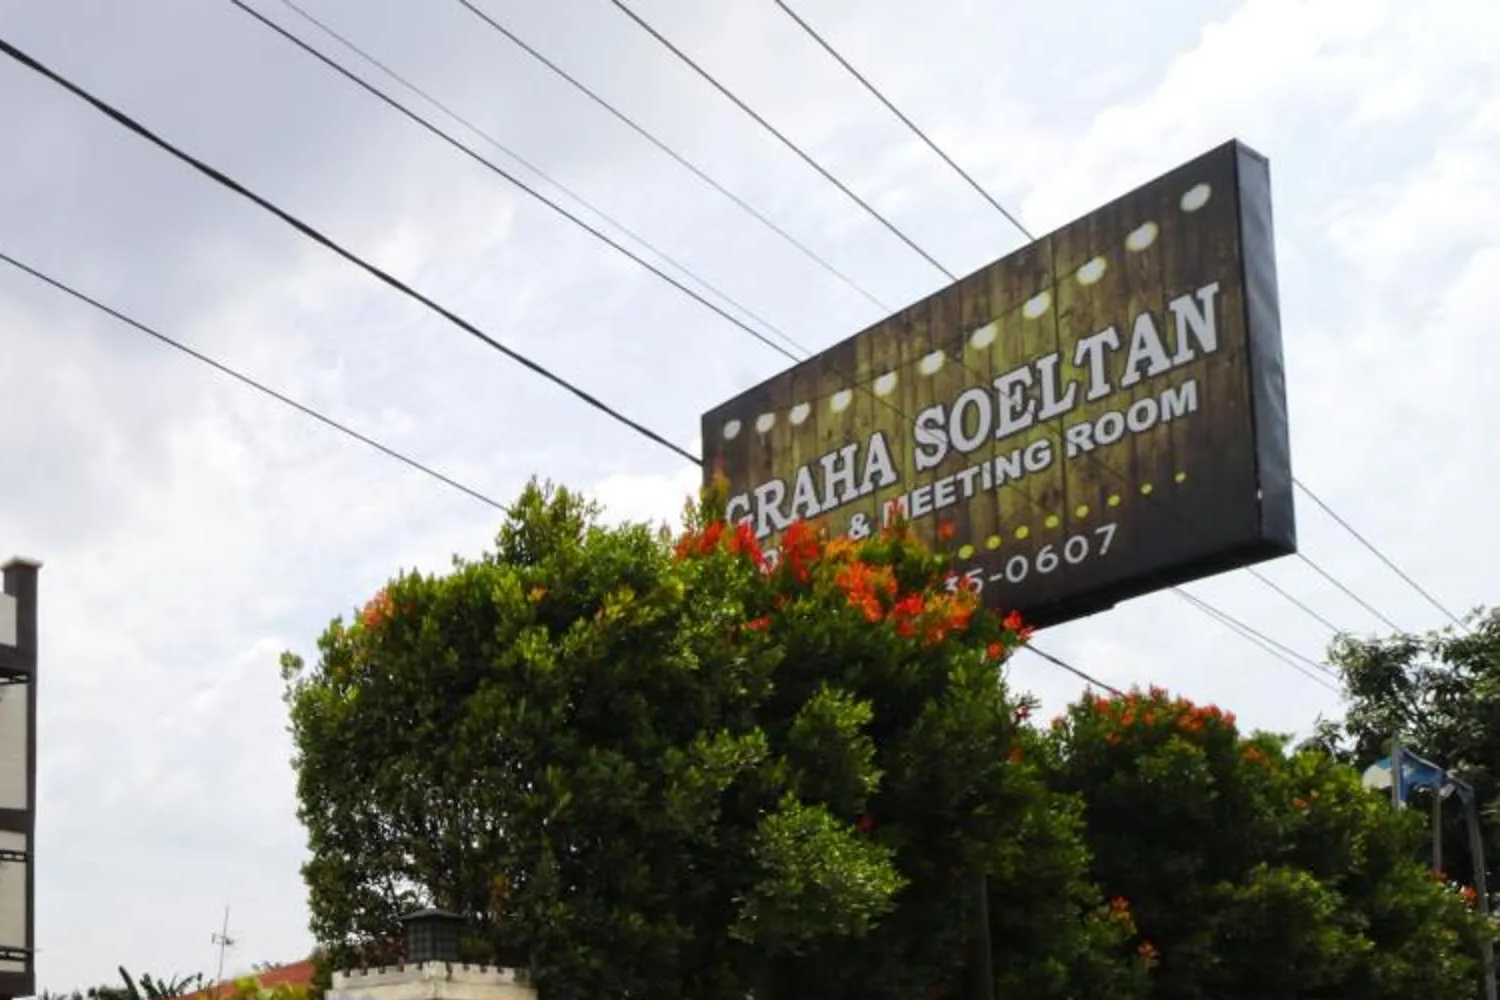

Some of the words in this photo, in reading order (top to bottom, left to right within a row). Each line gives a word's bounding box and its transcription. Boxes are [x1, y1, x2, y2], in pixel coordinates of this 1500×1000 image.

[725, 432, 897, 540] GRAHA
[913, 281, 1219, 471] SOELTAN
[849, 512, 871, 541] &
[883, 438, 1051, 528] MEETING
[1066, 379, 1198, 458] ROOM
